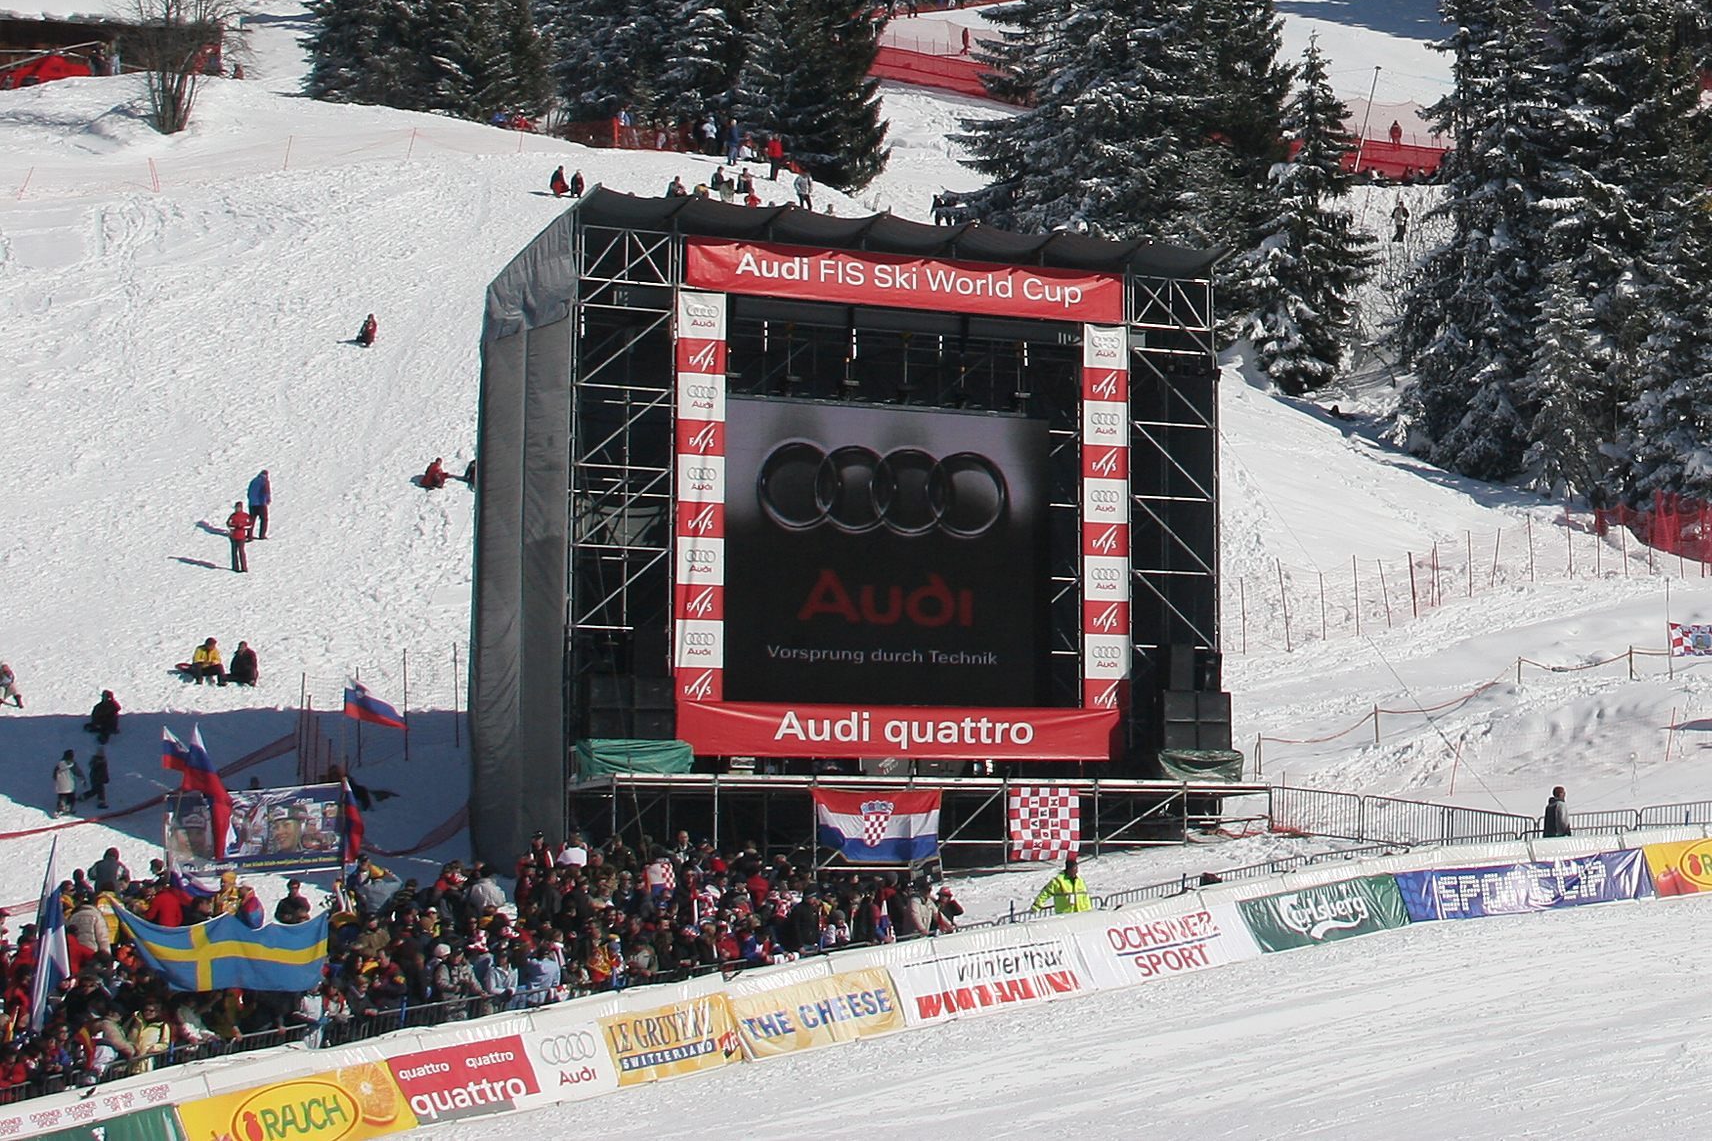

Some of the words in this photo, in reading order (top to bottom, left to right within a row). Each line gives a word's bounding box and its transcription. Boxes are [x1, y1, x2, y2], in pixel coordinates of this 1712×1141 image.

[735, 251, 810, 283] Audi
[819, 259, 865, 287] FIS
[873, 263, 919, 291] Ski
[925, 268, 1014, 299] World
[1022, 277, 1083, 308] Cup
[691, 319, 716, 328] Audi
[1095, 349, 1117, 358] Audi
[691, 399, 714, 409] Audi
[1095, 426, 1117, 435] Audi
[690, 481, 713, 491] Audi
[1094, 503, 1117, 513] Audi
[688, 564, 712, 573] Audi
[1095, 581, 1117, 590] Audi
[797, 568, 973, 627] Audi
[687, 647, 712, 656] Audi
[766, 644, 864, 664] Vorsprung
[871, 648, 923, 663] durch
[929, 649, 998, 665] Technik
[1096, 659, 1118, 668] Audi
[773, 710, 871, 742] Audi
[883, 716, 1034, 750] quattro
[1279, 894, 1369, 936] Carlsberg
[1106, 910, 1221, 951] OCHSNER
[1134, 943, 1210, 977] SPORT
[742, 1009, 796, 1040] THE
[800, 988, 893, 1029] CHEESE
[608, 1022, 632, 1054] LE
[399, 1062, 451, 1081] quattro
[465, 1050, 515, 1069] quattro
[622, 1041, 714, 1070] SWITZERLAND
[559, 1067, 597, 1086] Audi
[110, 1100, 133, 1111] SPRT
[410, 1077, 527, 1119] quattro
[260, 1094, 348, 1141] RAUCH
